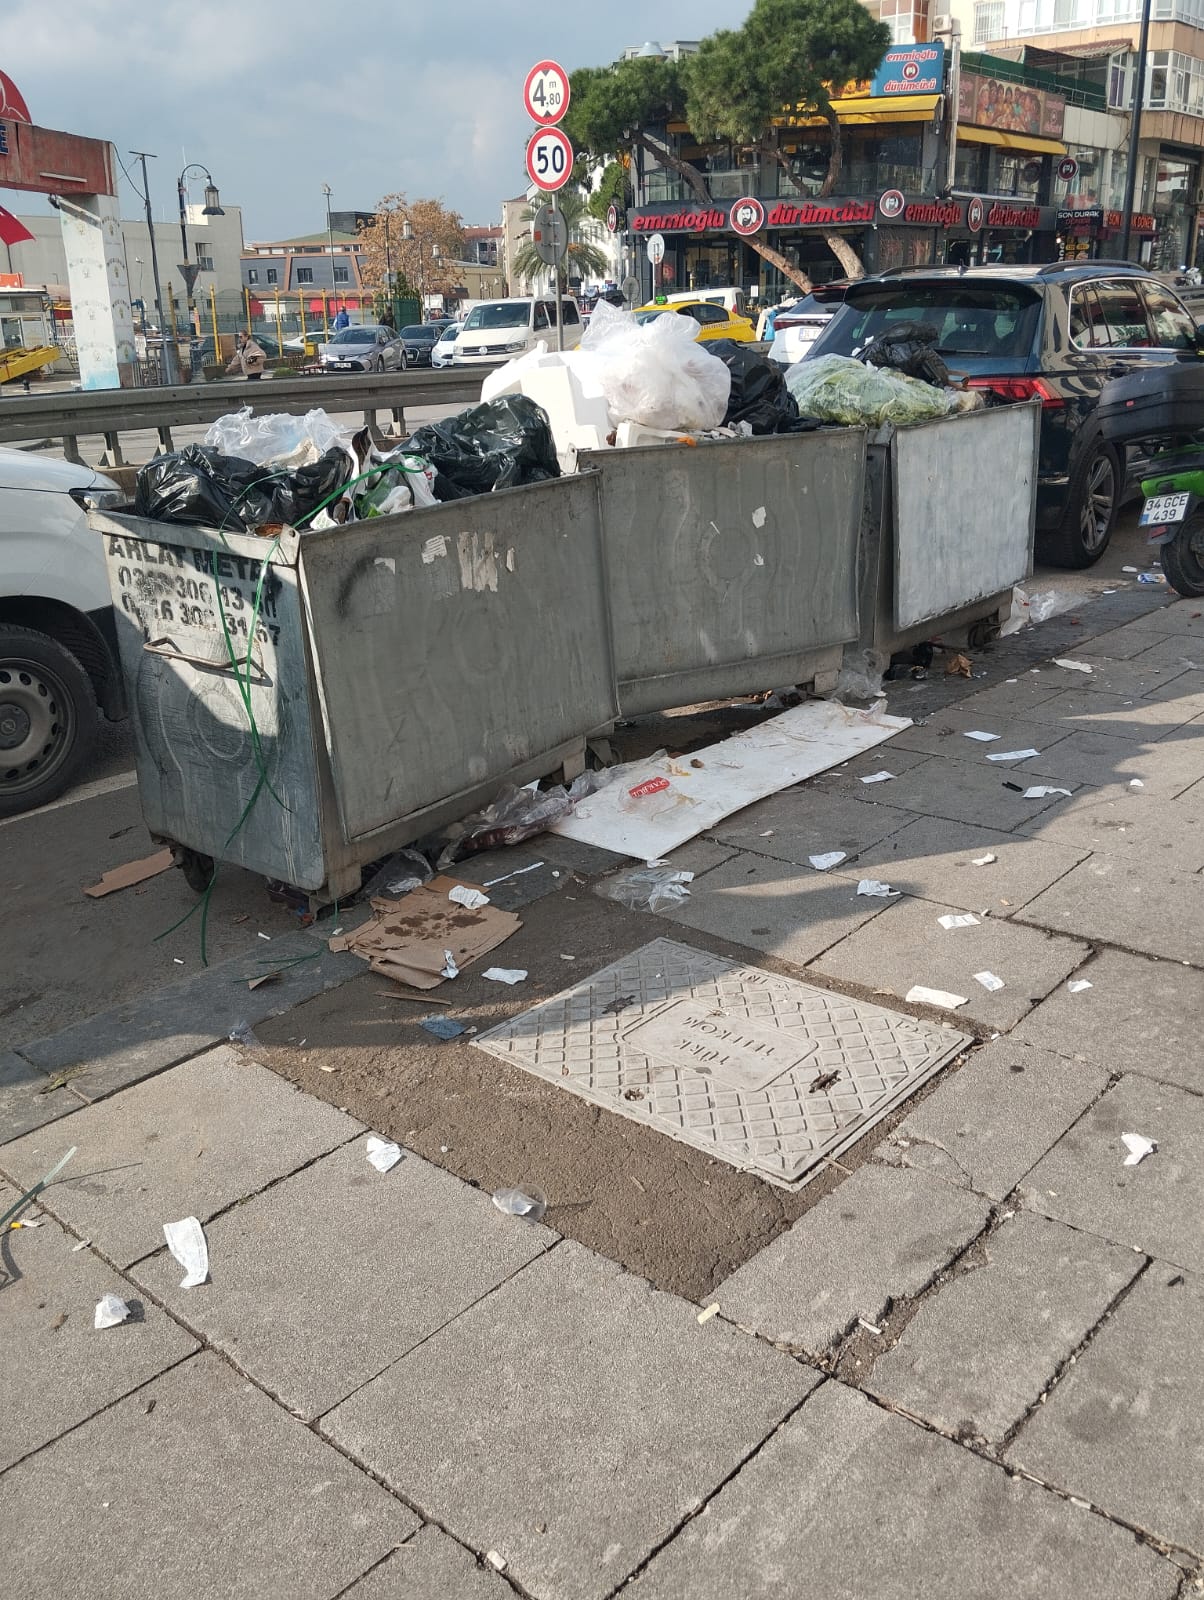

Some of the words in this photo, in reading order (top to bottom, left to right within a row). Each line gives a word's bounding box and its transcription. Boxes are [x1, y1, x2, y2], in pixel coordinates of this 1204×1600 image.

[537, 145, 564, 173] 50
[633, 210, 725, 232] emmioğlu
[768, 202, 875, 226] dürümcüsü
[1146, 500, 1161, 511] 34
[1164, 494, 1188, 508] GCE
[1153, 509, 1177, 521] 439
[109, 536, 186, 568] AHLAT
[193, 550, 275, 582] META
